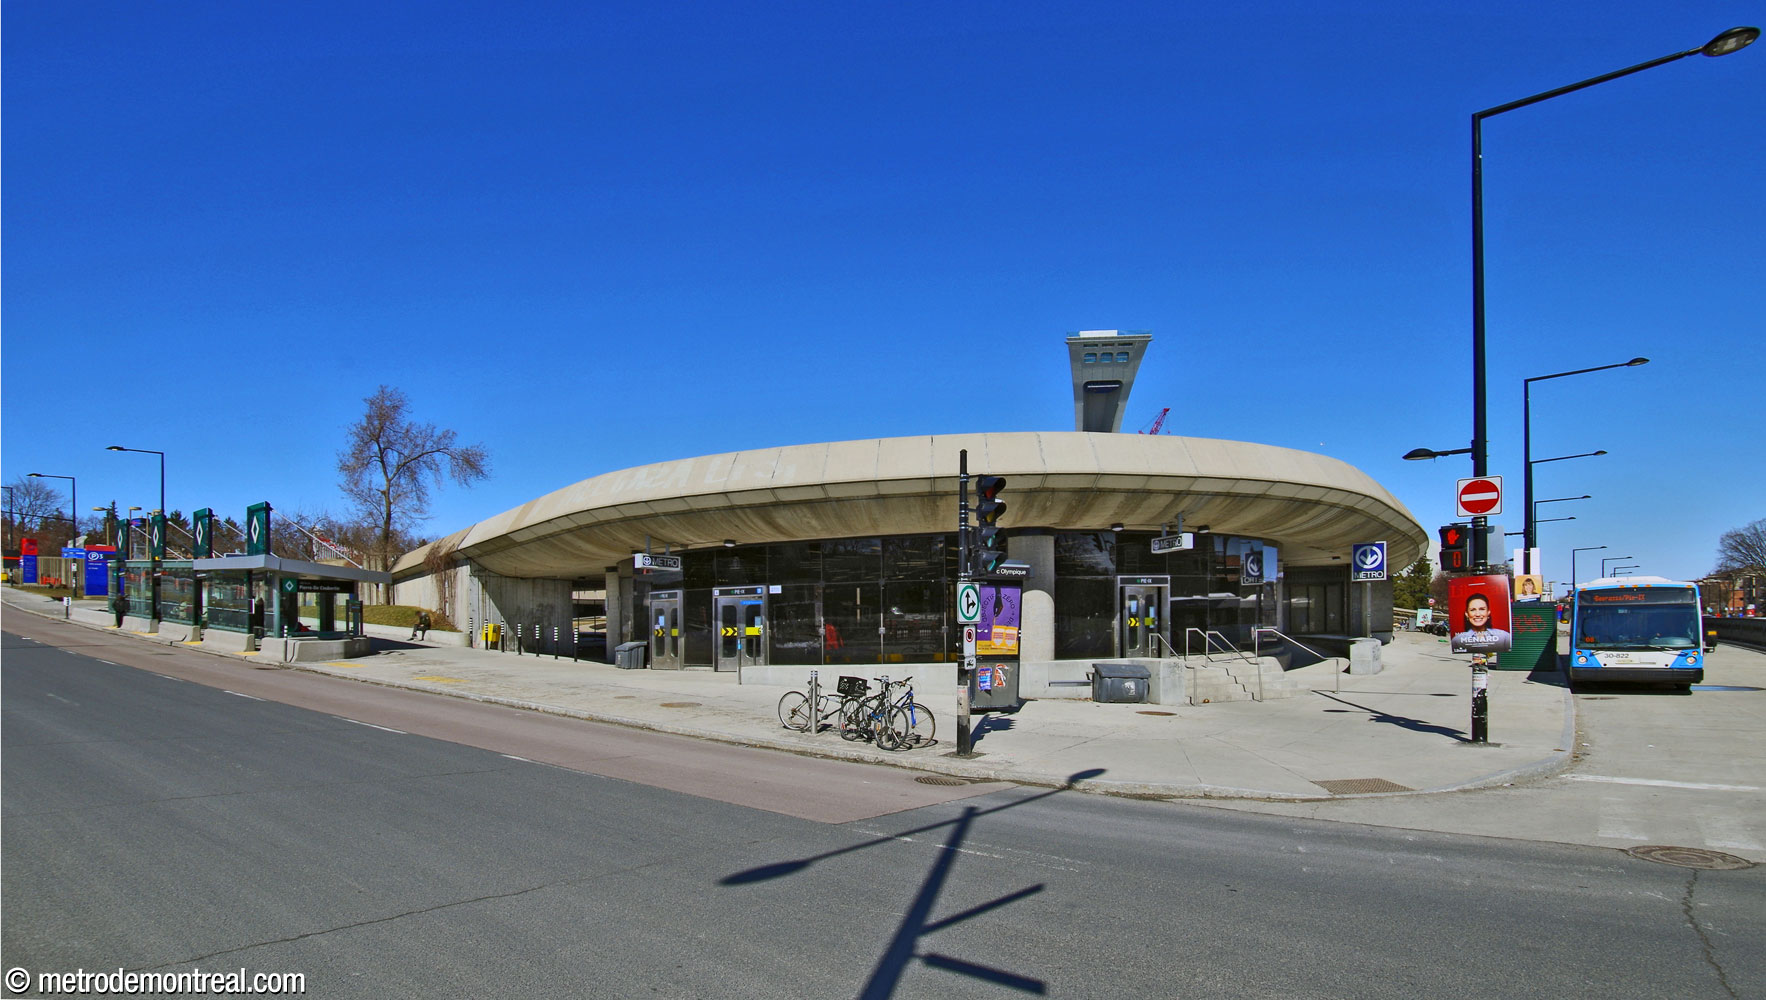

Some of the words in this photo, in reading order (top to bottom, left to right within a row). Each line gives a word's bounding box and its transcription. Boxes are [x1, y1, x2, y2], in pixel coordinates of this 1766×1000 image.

[1160, 536, 1181, 549] METRO
[652, 558, 678, 568] METRO
[1355, 571, 1384, 579] METRO
